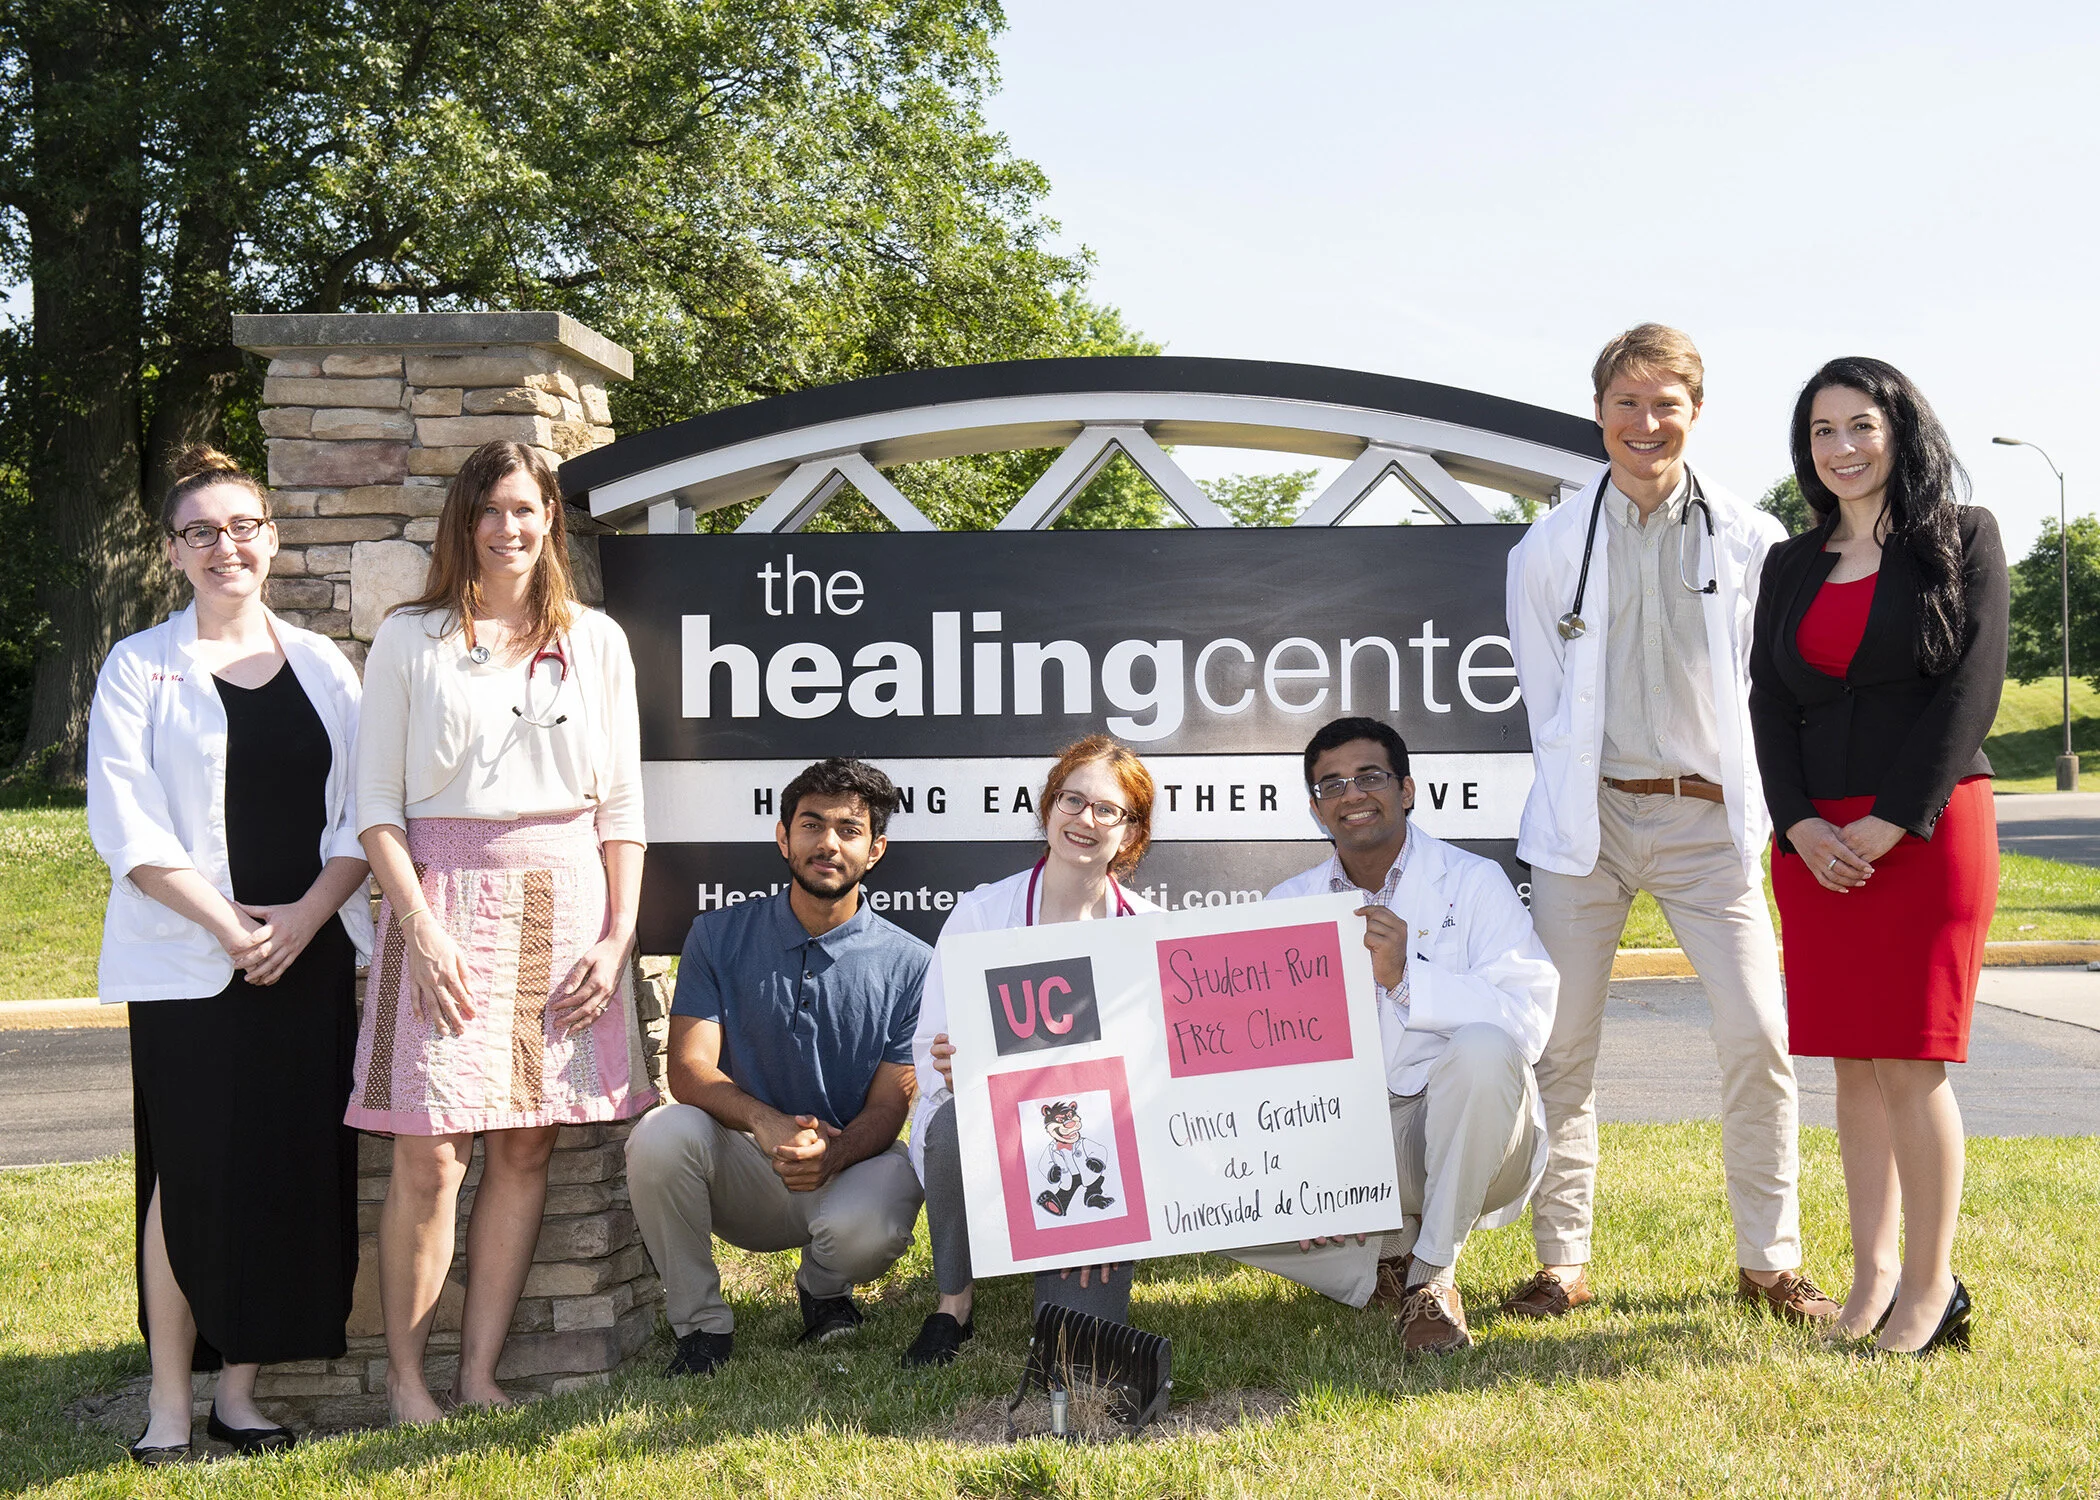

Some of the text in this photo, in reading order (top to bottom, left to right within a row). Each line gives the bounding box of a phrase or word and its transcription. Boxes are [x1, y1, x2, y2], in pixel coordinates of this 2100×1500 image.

[757, 554, 865, 616] the
[681, 611, 1522, 742] healingcente
[984, 786, 1034, 813] EA
[1164, 784, 1278, 812] THER
[1169, 948, 1329, 1005] Student-Run
[998, 976, 1074, 1039] UC
[1173, 1008, 1323, 1065] FREE Clinic
[1168, 1094, 1341, 1147] Clinica Gratuita
[1224, 1151, 1282, 1180] de la
[1164, 1179, 1393, 1235] Universidad de Cincinnati
